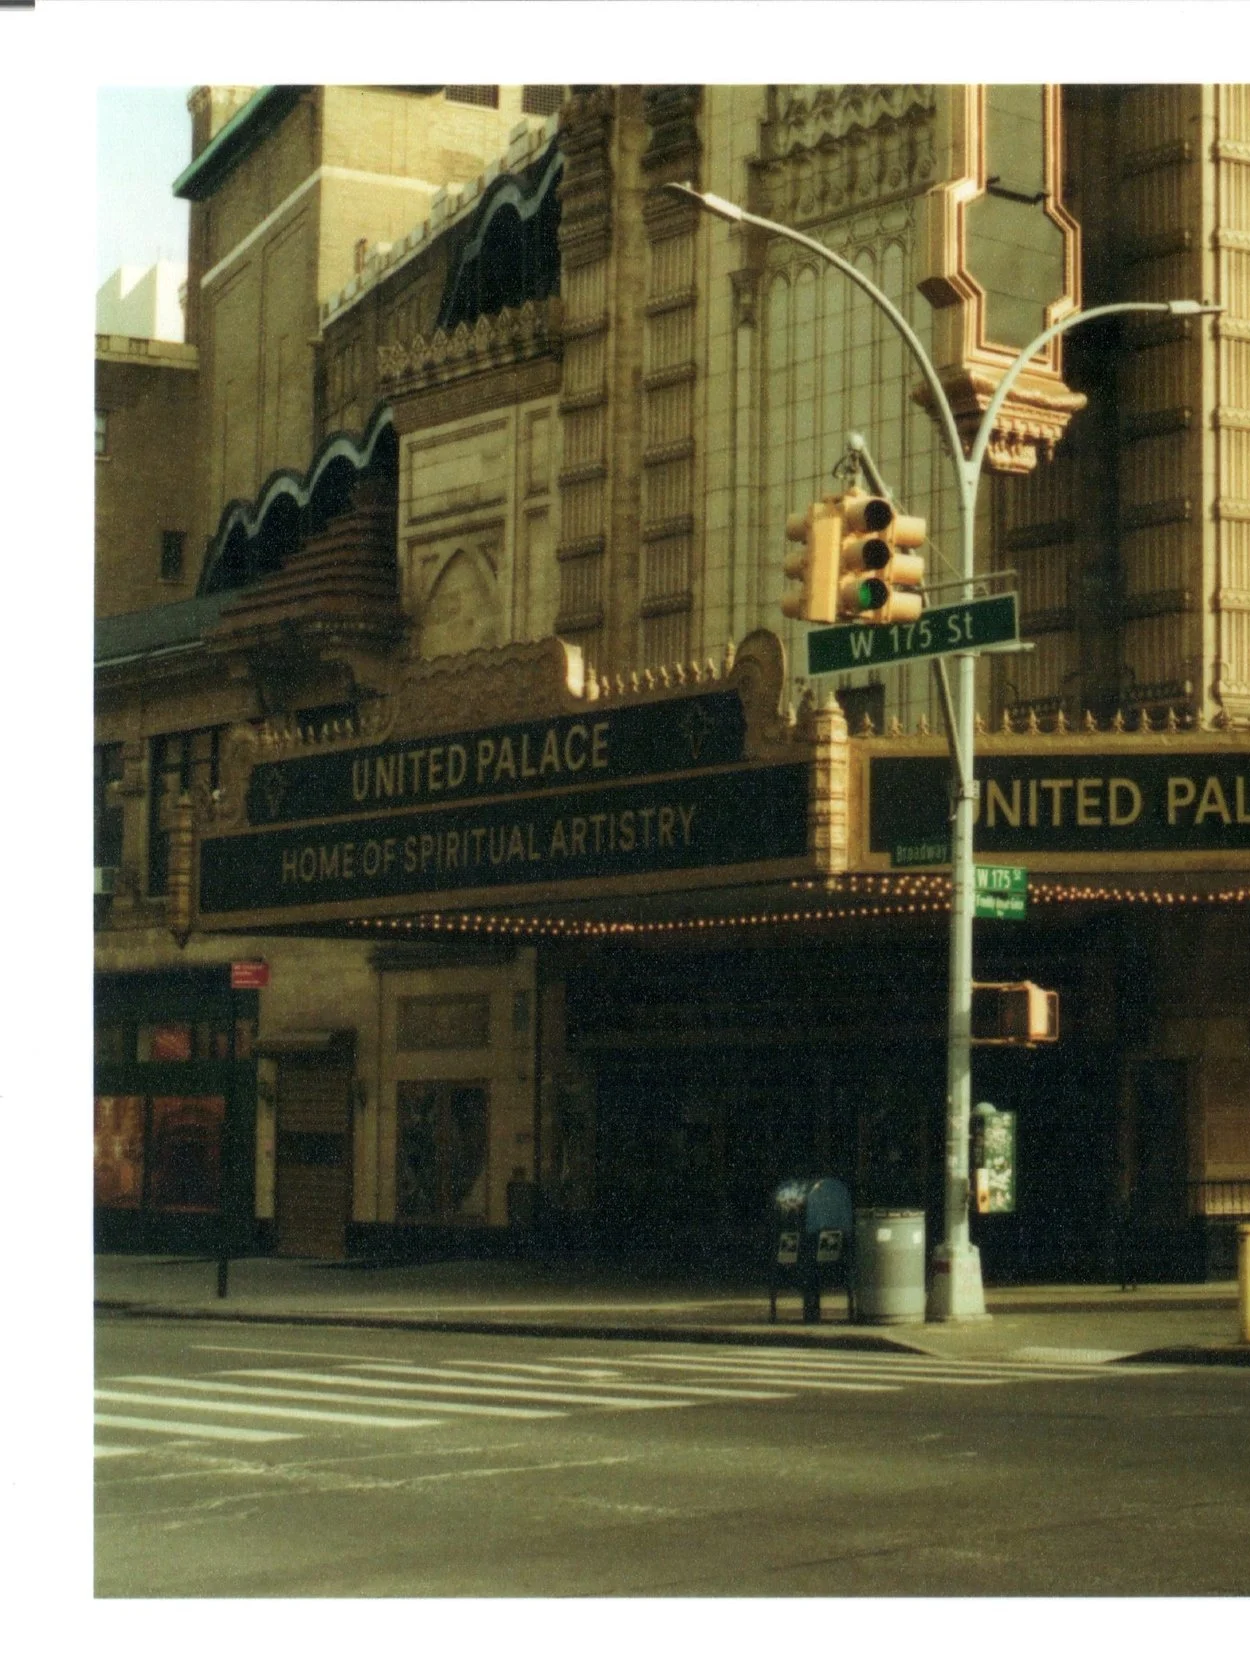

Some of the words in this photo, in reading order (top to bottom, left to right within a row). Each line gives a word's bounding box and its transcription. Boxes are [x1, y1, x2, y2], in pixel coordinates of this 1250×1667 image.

[850, 630, 874, 659] W
[890, 619, 932, 653] 175
[948, 611, 973, 643] St
[352, 743, 467, 801] UNITED
[476, 721, 610, 785] PALACE
[950, 777, 1143, 828] NITED
[281, 842, 354, 885] HOME
[362, 837, 397, 878] OF
[404, 824, 541, 873] SPIRITUAL
[548, 804, 697, 859] ARTISTRY
[977, 868, 989, 889] W
[992, 869, 1011, 889] 175
